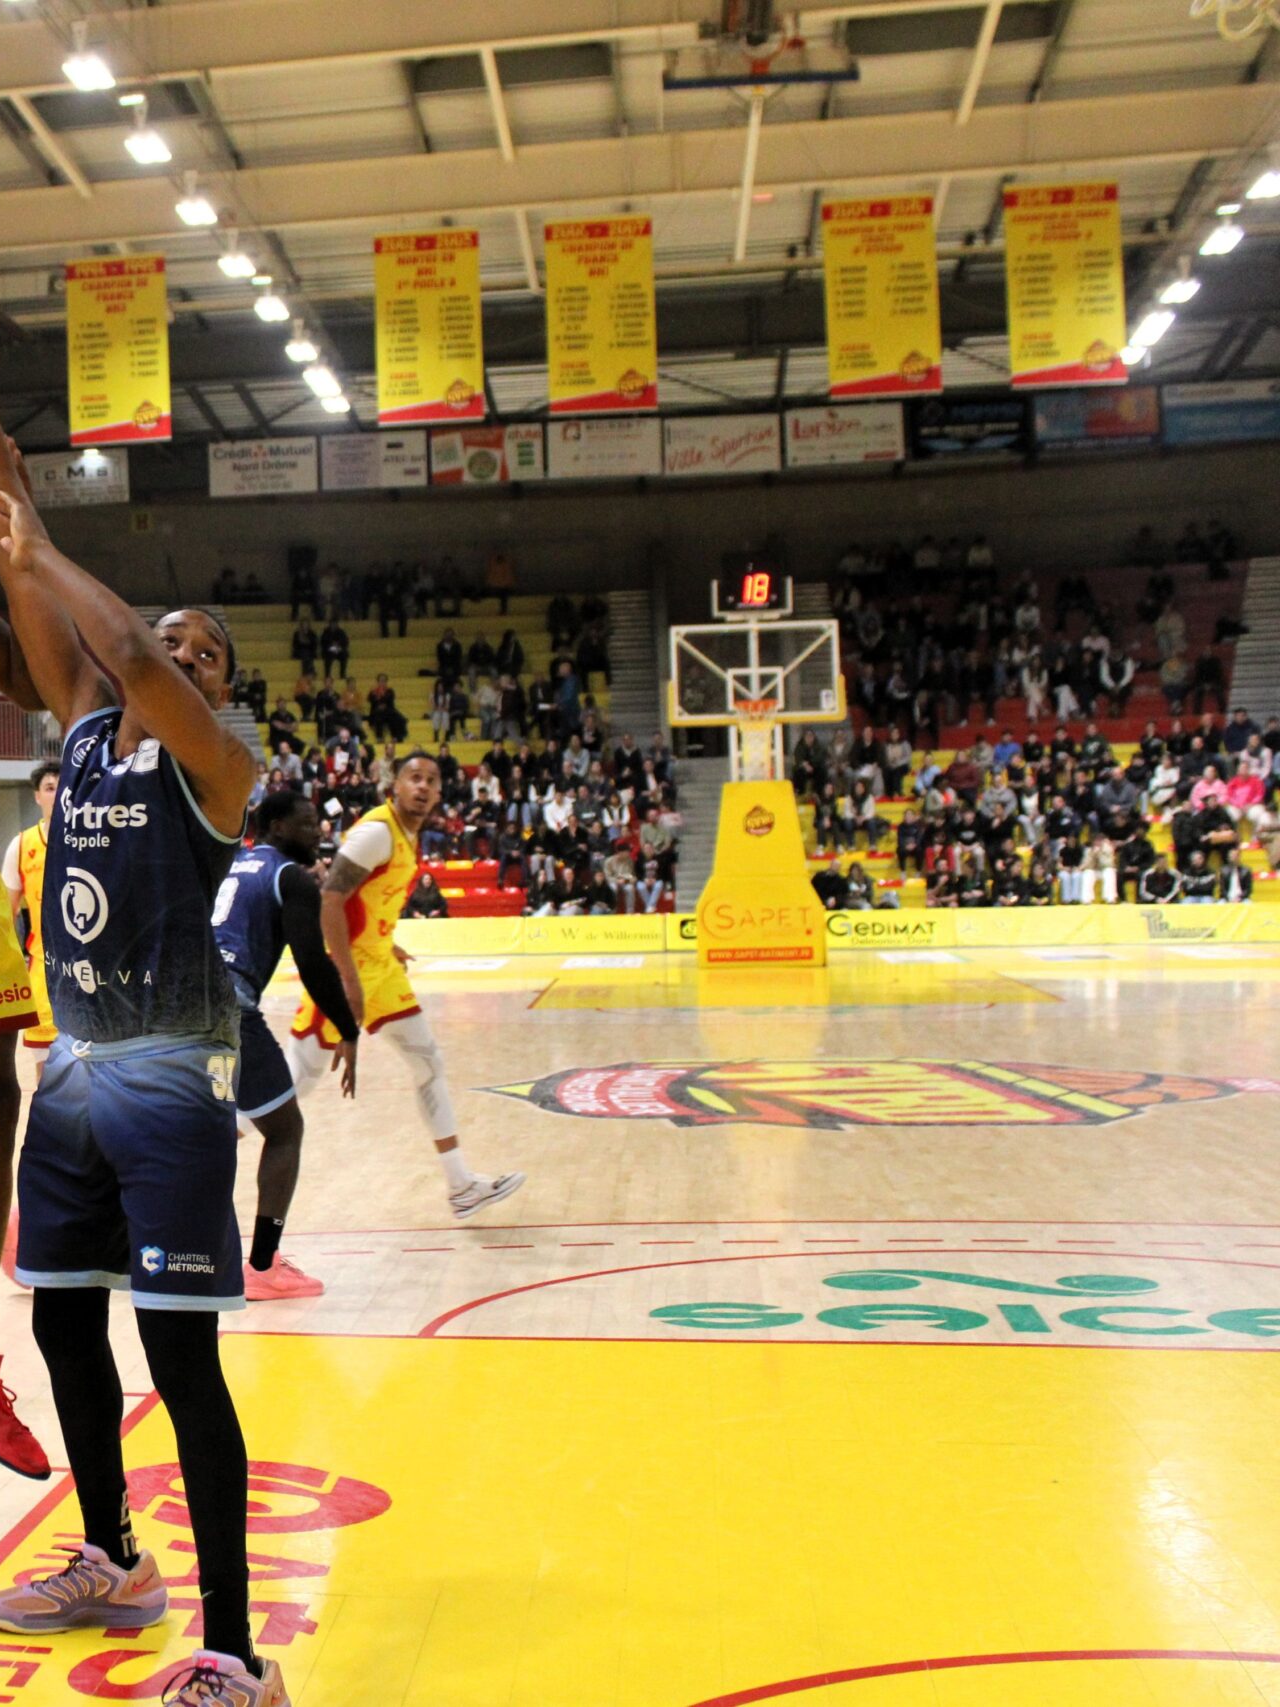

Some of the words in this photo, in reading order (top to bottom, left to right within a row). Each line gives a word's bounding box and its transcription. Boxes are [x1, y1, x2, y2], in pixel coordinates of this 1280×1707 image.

[742, 573, 770, 605] 18
[716, 904, 812, 929] SAPET
[167, 1252, 210, 1264] CHARTRES
[167, 1261, 215, 1275] MÉTROPOLE
